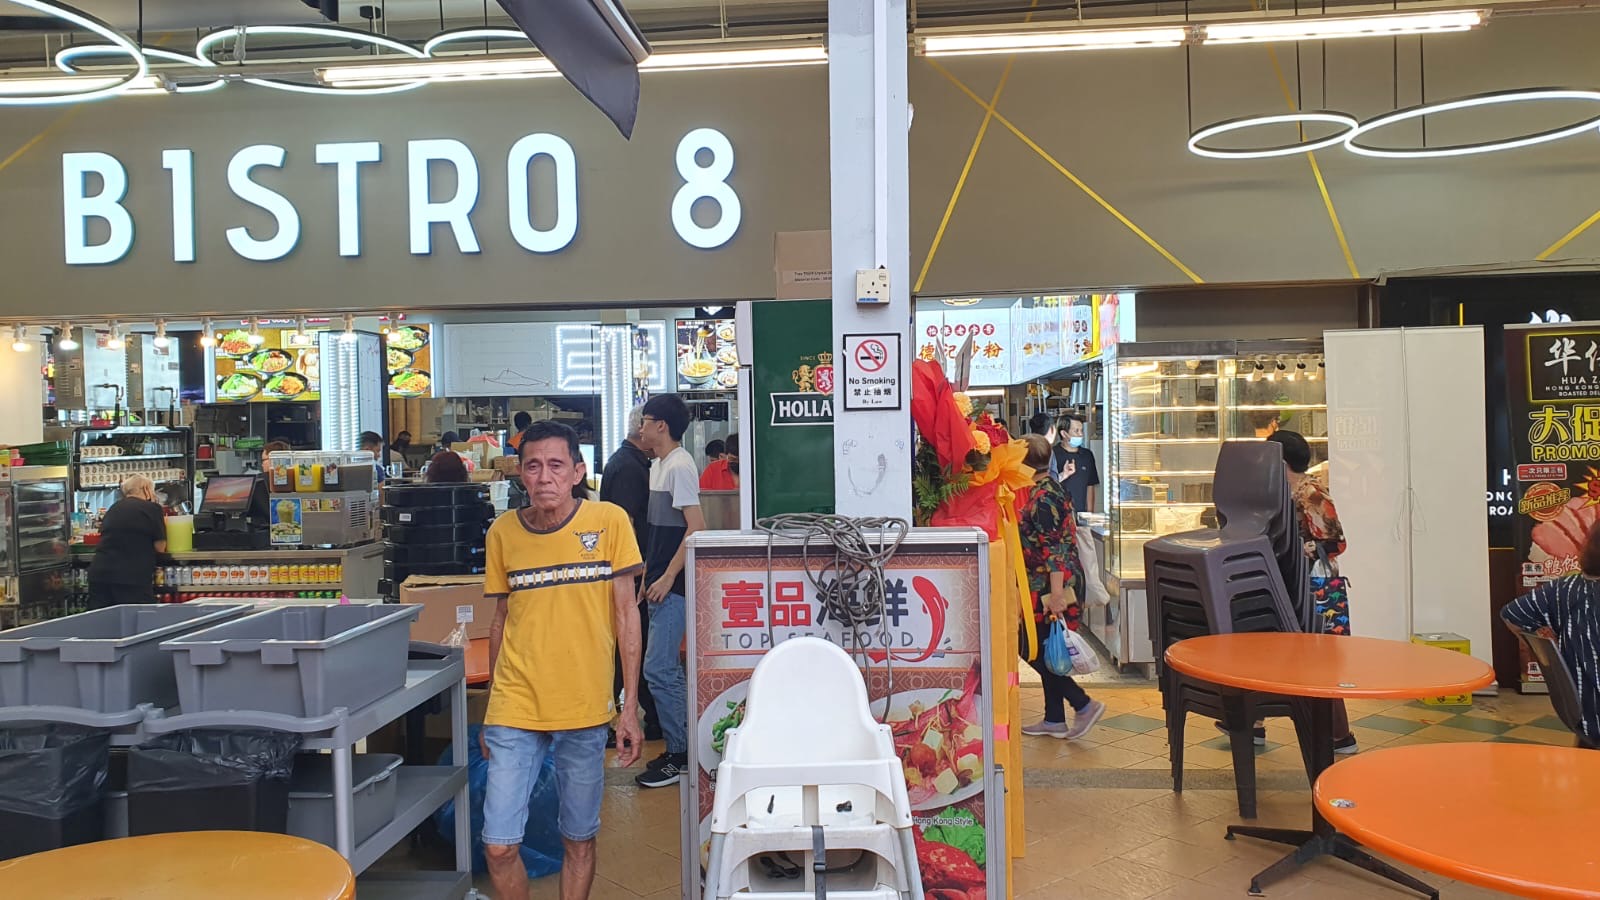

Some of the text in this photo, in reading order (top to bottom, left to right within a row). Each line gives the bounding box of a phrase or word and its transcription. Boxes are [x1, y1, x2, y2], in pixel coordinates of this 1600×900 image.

[671, 128, 742, 249] 8
[848, 376, 896, 386] No Smoking
[1561, 376, 1586, 385] HUA
[721, 632, 771, 649] TOP
[911, 816, 973, 827] Hong Kong Style
